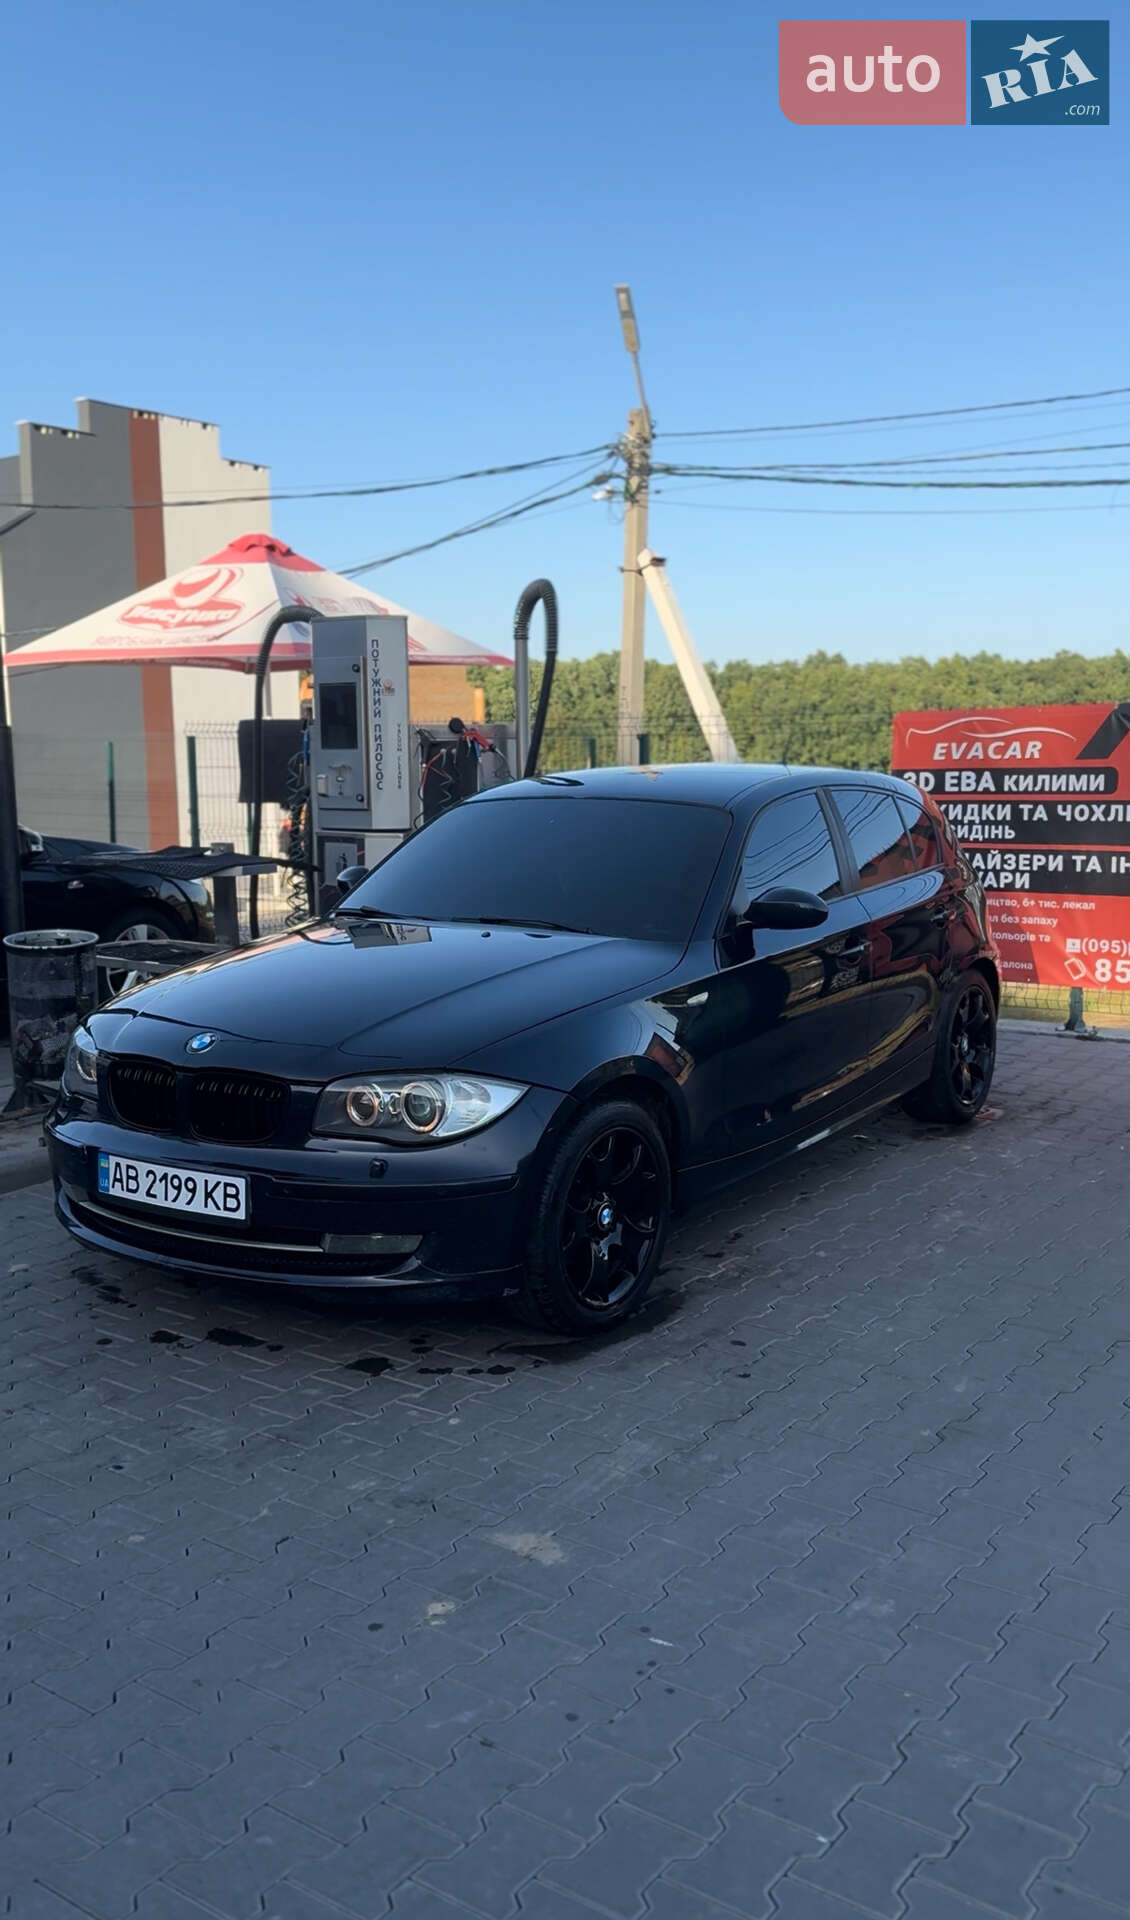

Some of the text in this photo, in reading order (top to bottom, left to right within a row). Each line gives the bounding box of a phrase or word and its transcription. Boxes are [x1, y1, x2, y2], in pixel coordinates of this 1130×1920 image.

[371, 639, 384, 790] ПОТУЖНИЙ ПИЛОСОС
[933, 741, 1043, 760] EVACAR
[1018, 804, 1049, 821] ТА
[1071, 855, 1102, 873] ТА
[1081, 937, 1130, 957] (095)
[111, 1161, 241, 1213] AB 2199 KB
